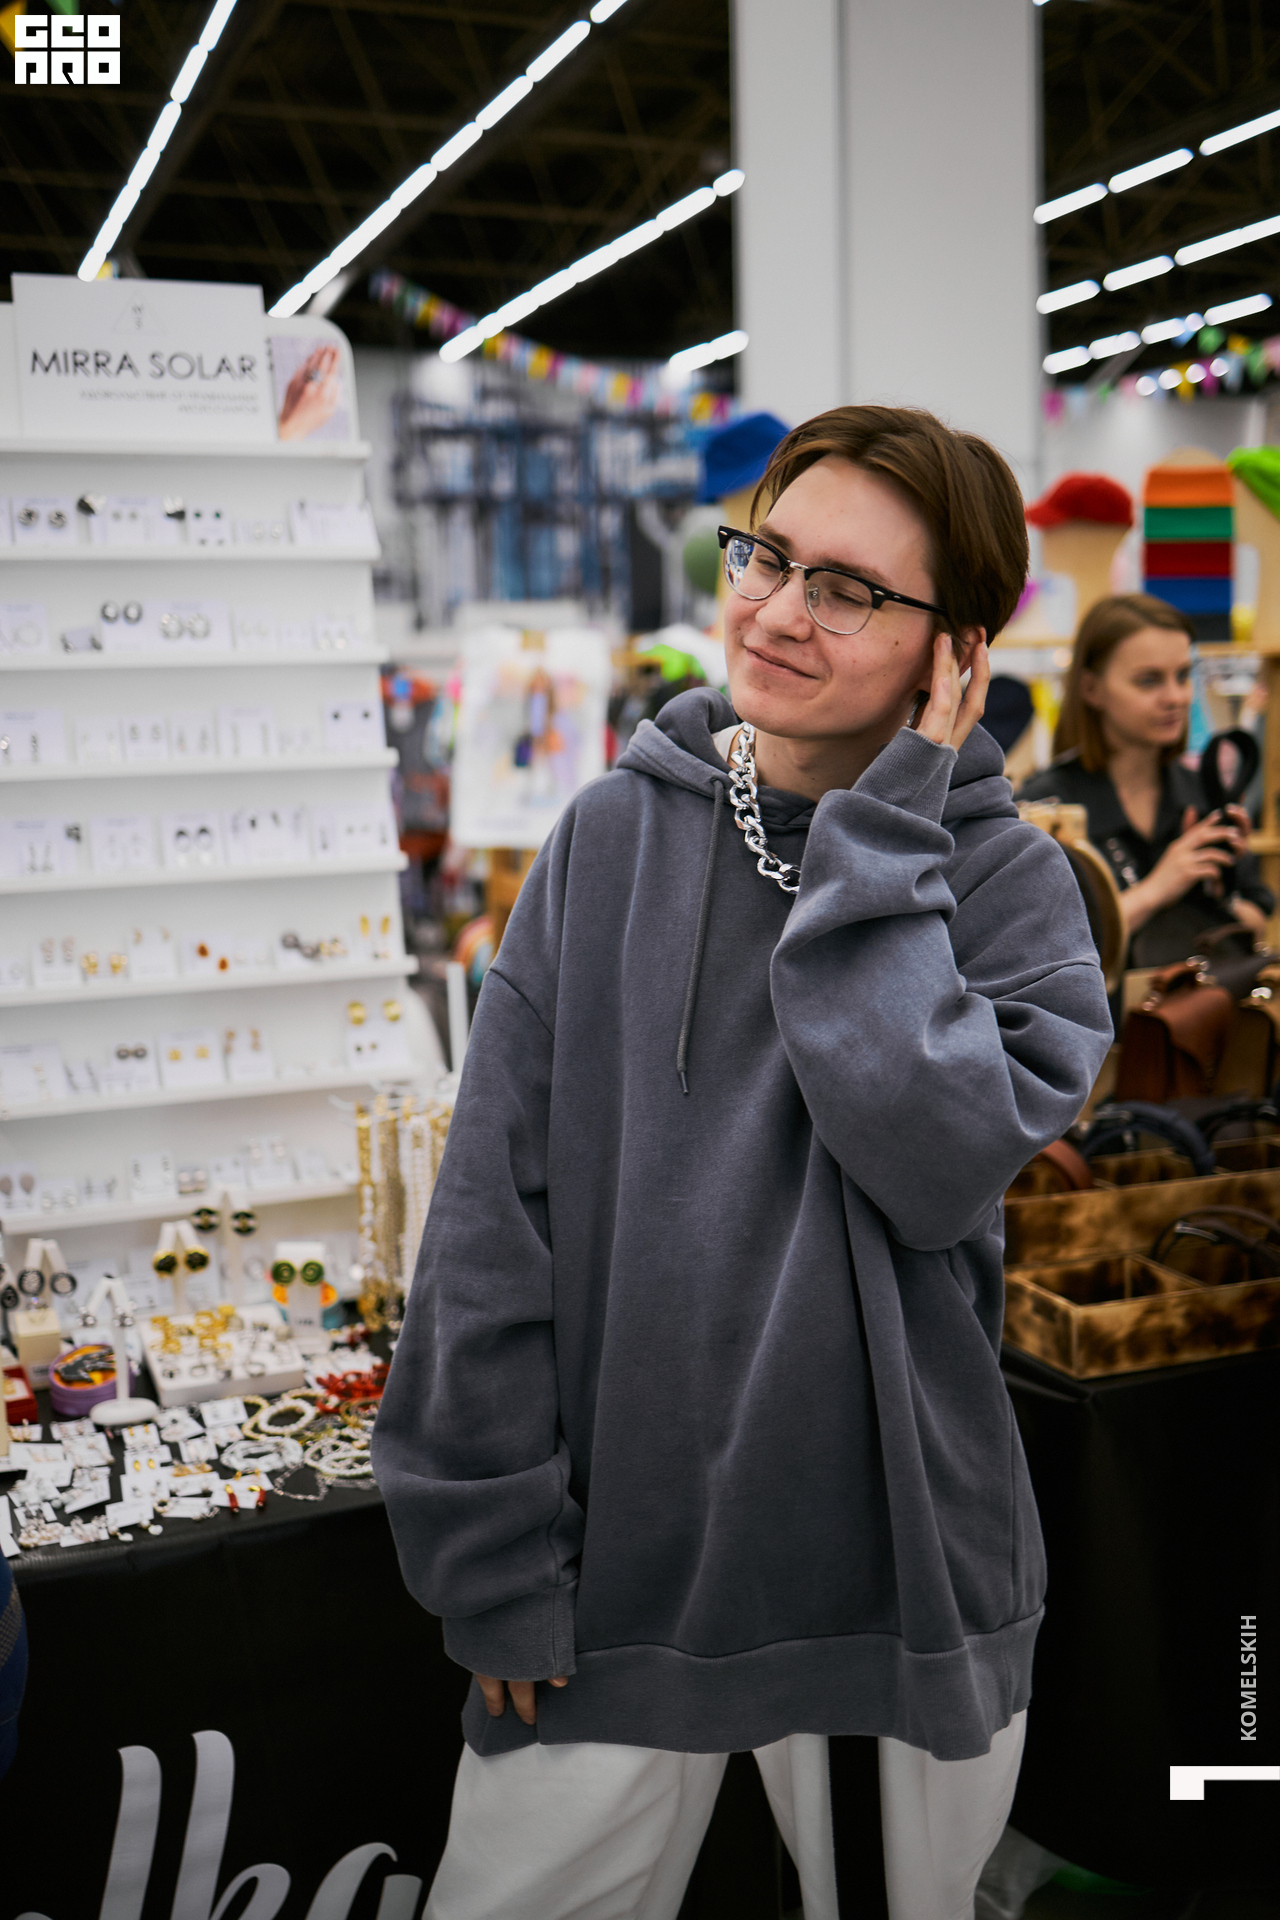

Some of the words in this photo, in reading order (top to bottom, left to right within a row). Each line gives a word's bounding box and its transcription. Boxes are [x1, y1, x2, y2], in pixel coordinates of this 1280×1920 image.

[31, 350, 139, 378] MIRRA
[150, 351, 257, 381] SOLAR
[14, 1730, 423, 1920] lka
